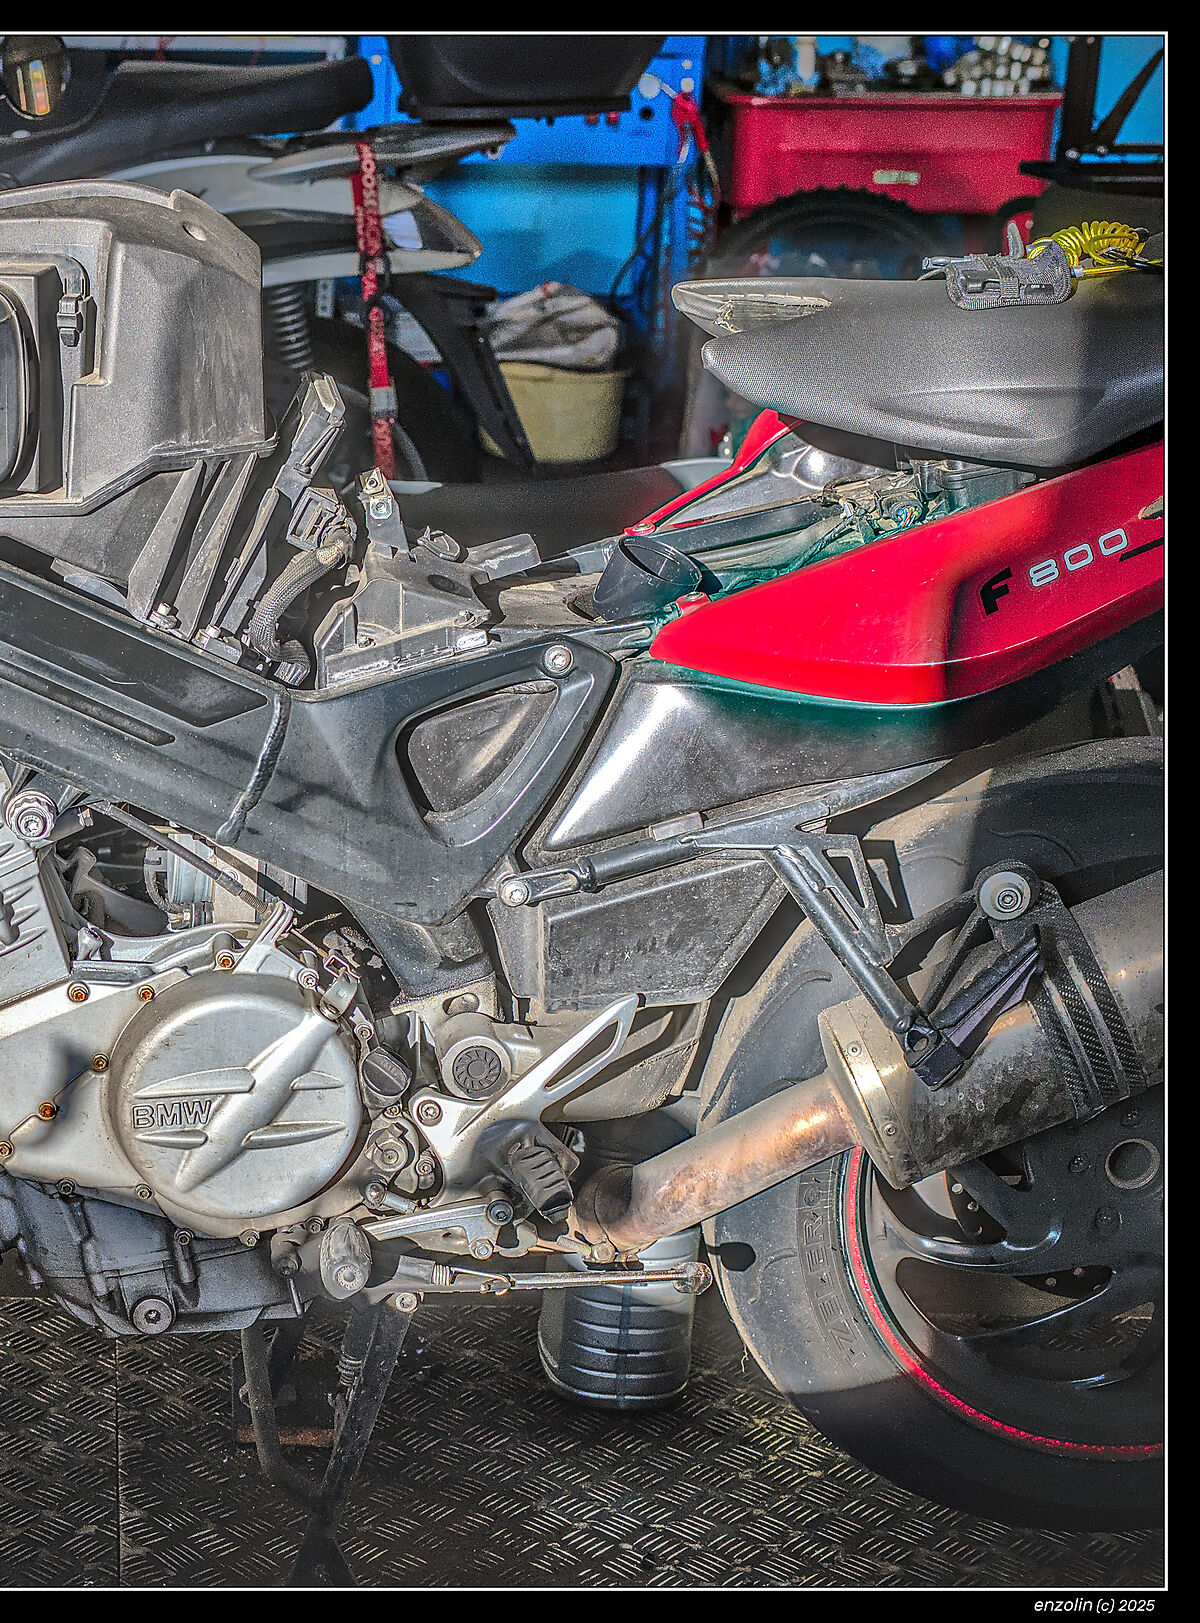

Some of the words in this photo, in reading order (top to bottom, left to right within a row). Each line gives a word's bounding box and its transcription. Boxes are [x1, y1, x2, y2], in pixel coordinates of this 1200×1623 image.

[979, 566, 1013, 617] F
[1028, 527, 1129, 588] 800
[132, 1099, 213, 1130] BMW
